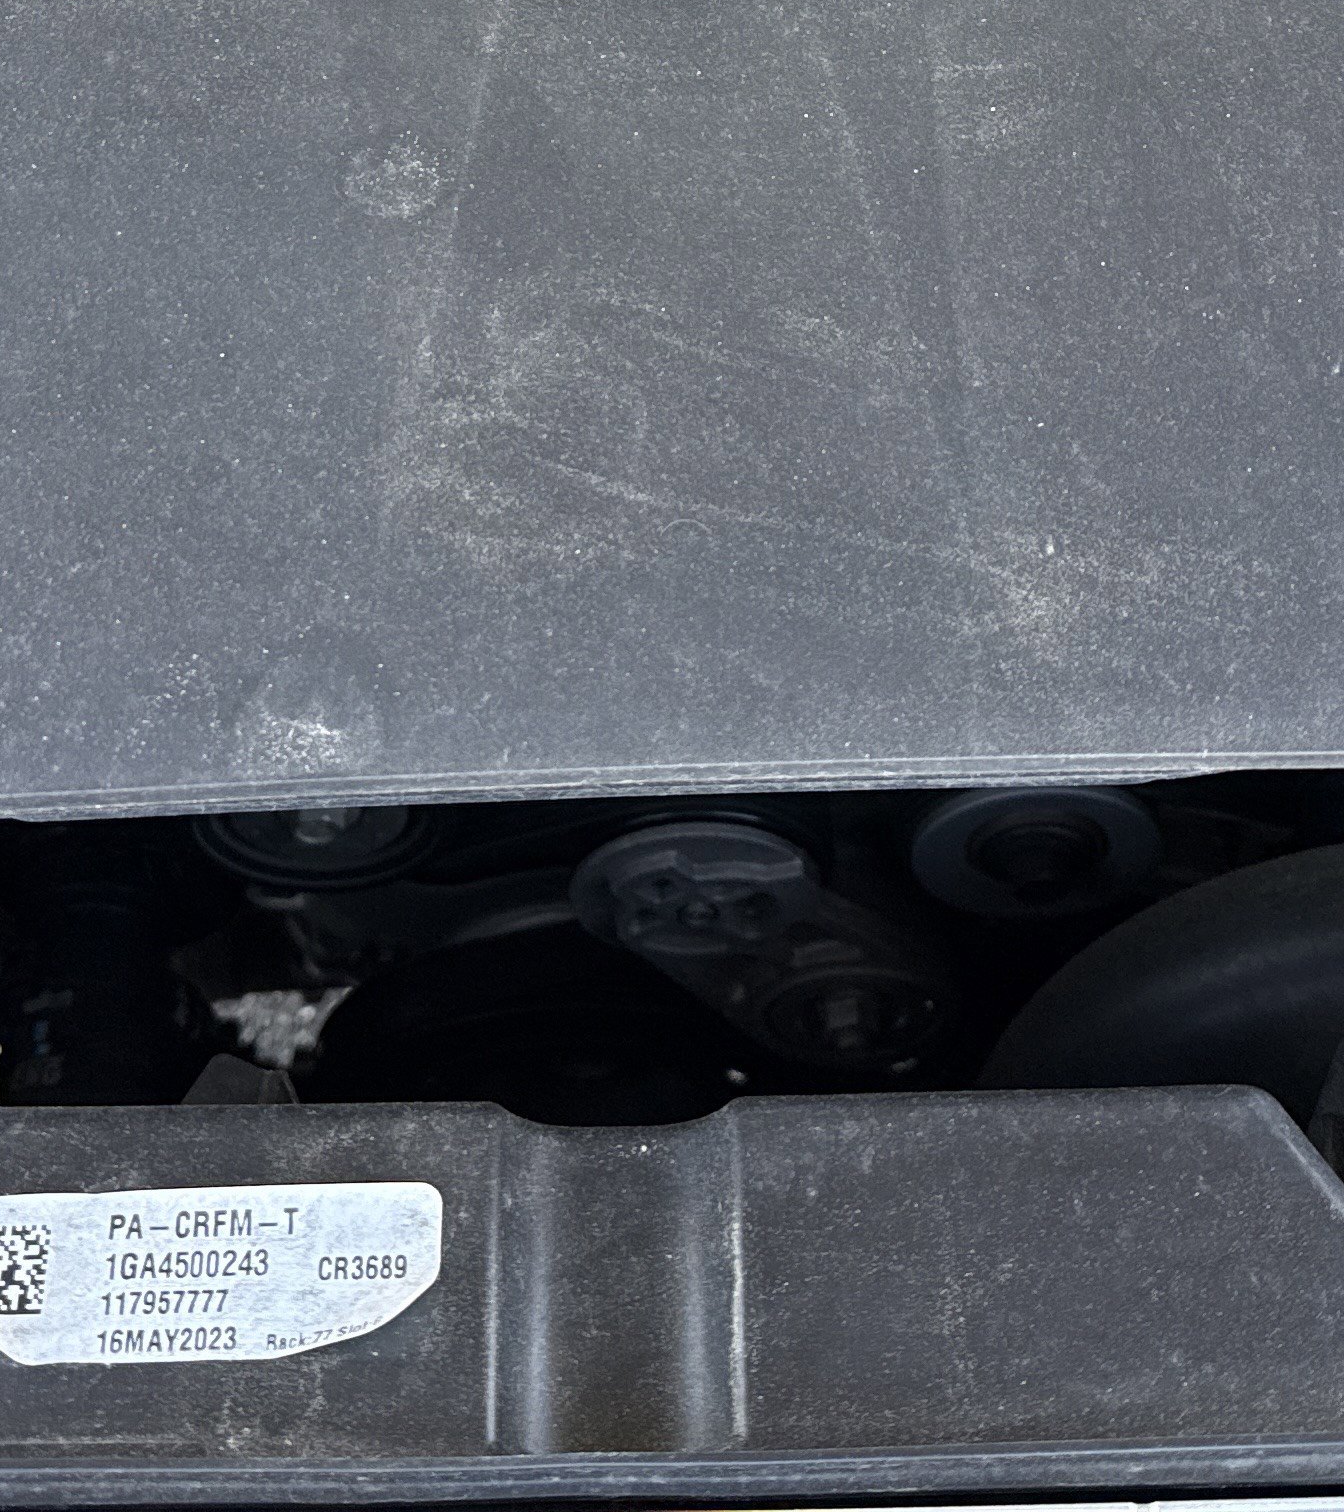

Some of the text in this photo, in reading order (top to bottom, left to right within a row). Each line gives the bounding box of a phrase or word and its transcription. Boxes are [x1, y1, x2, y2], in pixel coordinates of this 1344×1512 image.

[109, 1207, 299, 1240] PA-CRFM-T
[105, 1250, 408, 1281] 1GA4500243 CR3689
[100, 1288, 229, 1316] 117957777
[96, 1325, 237, 1355] 16MAY2023
